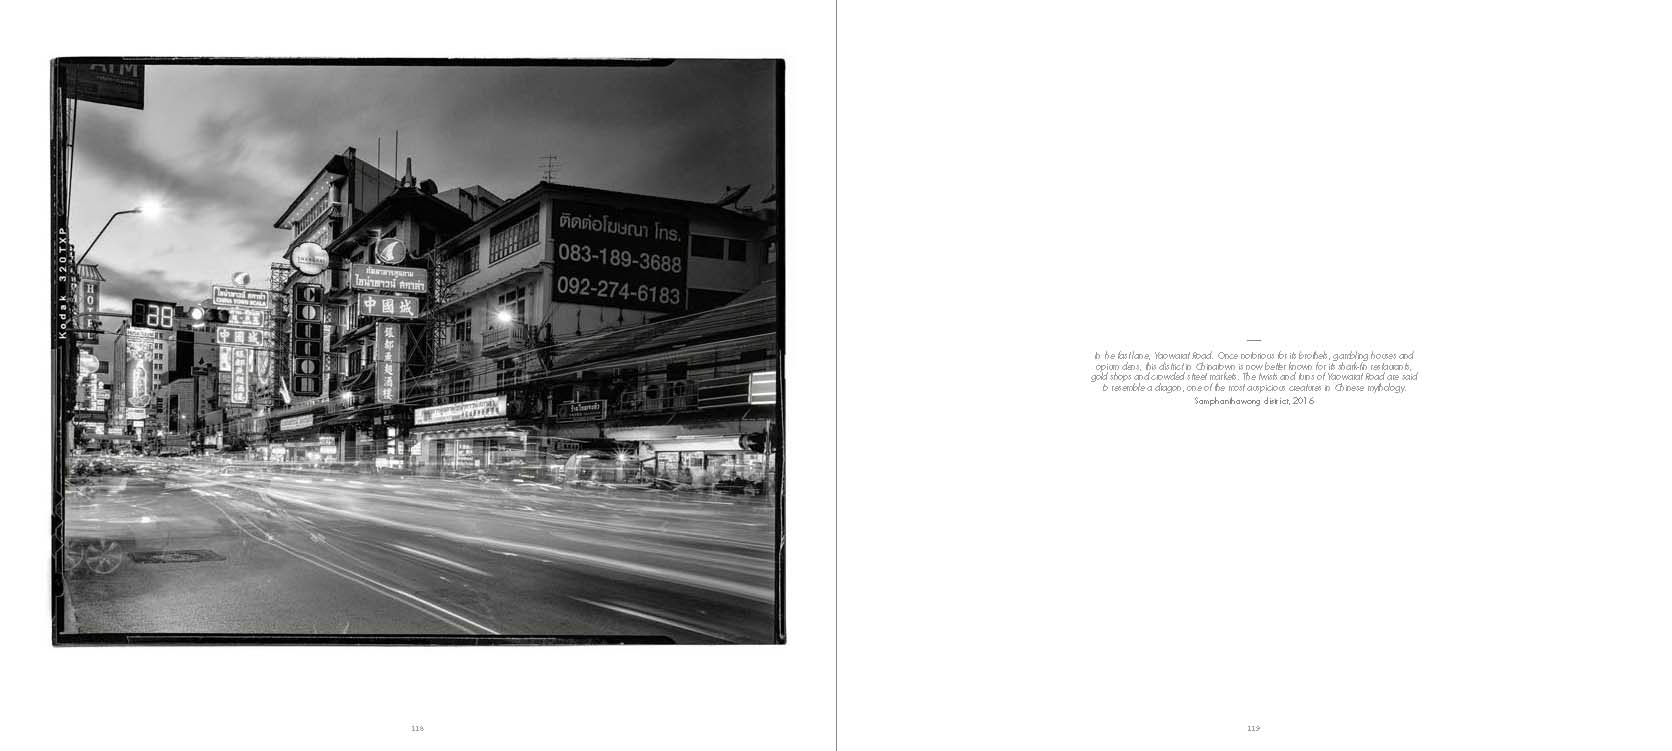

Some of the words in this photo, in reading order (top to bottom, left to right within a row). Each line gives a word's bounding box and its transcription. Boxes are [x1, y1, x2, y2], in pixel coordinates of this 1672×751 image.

[59, 228, 67, 282] 320TXP
[558, 243, 682, 274] 083-189-3688
[364, 296, 414, 316] 中國城
[557, 276, 680, 305] 092-274-6183
[59, 295, 67, 339] Kodak
[87, 284, 96, 340] HOTEL
[1194, 397, 1261, 406] Samphanthawong
[1263, 397, 1290, 405] district,
